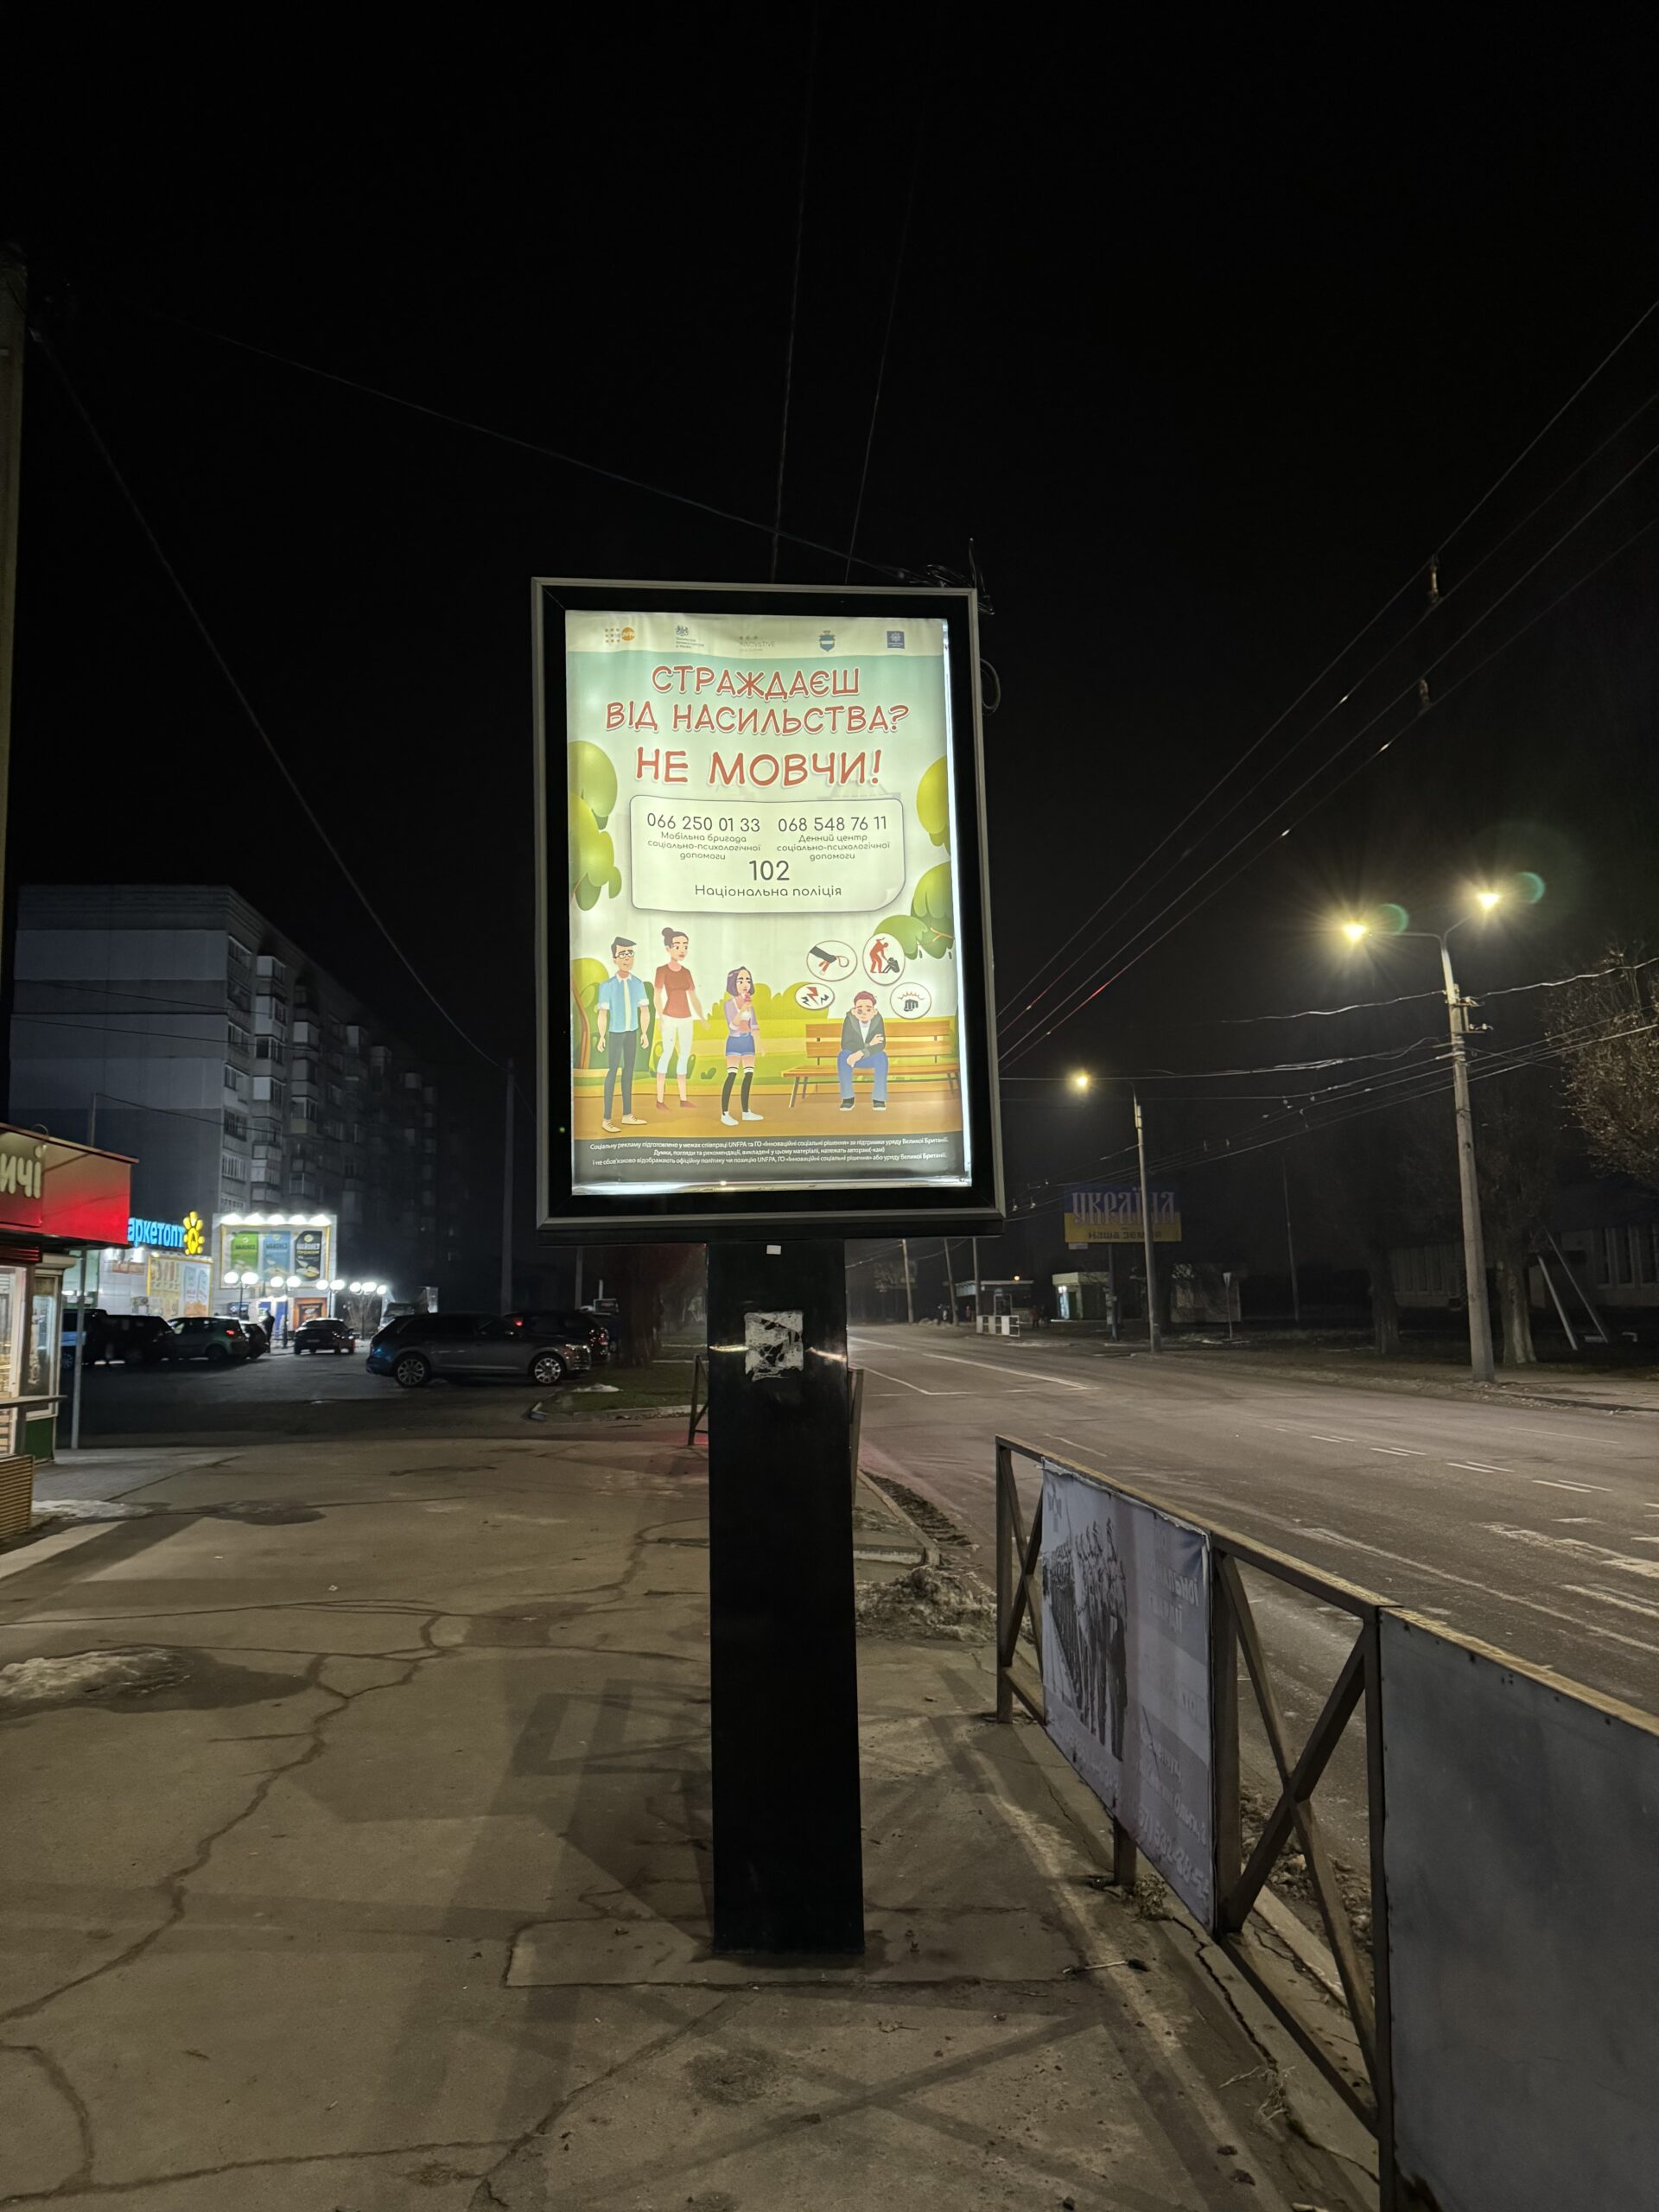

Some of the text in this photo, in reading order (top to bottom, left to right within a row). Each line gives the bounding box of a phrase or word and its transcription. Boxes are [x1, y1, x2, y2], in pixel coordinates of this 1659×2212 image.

[652, 664, 861, 702] СТРАЖДАЄШ
[606, 701, 910, 735] ВІД НАСИЛЬСТВА?
[635, 747, 881, 788] НЕ МОВЧИ!
[646, 813, 760, 832] 066 250 01 33
[778, 816, 887, 832] 068 548 76 11
[661, 831, 747, 843] Мобільна бригада
[798, 833, 868, 844] Денний центр
[647, 839, 761, 852] соціально-психологічної
[777, 842, 891, 854] соціально-психологічної
[679, 851, 726, 861] допомоги
[809, 851, 855, 862] допомоги
[749, 860, 790, 881] 102
[695, 885, 842, 899] Національна поліція
